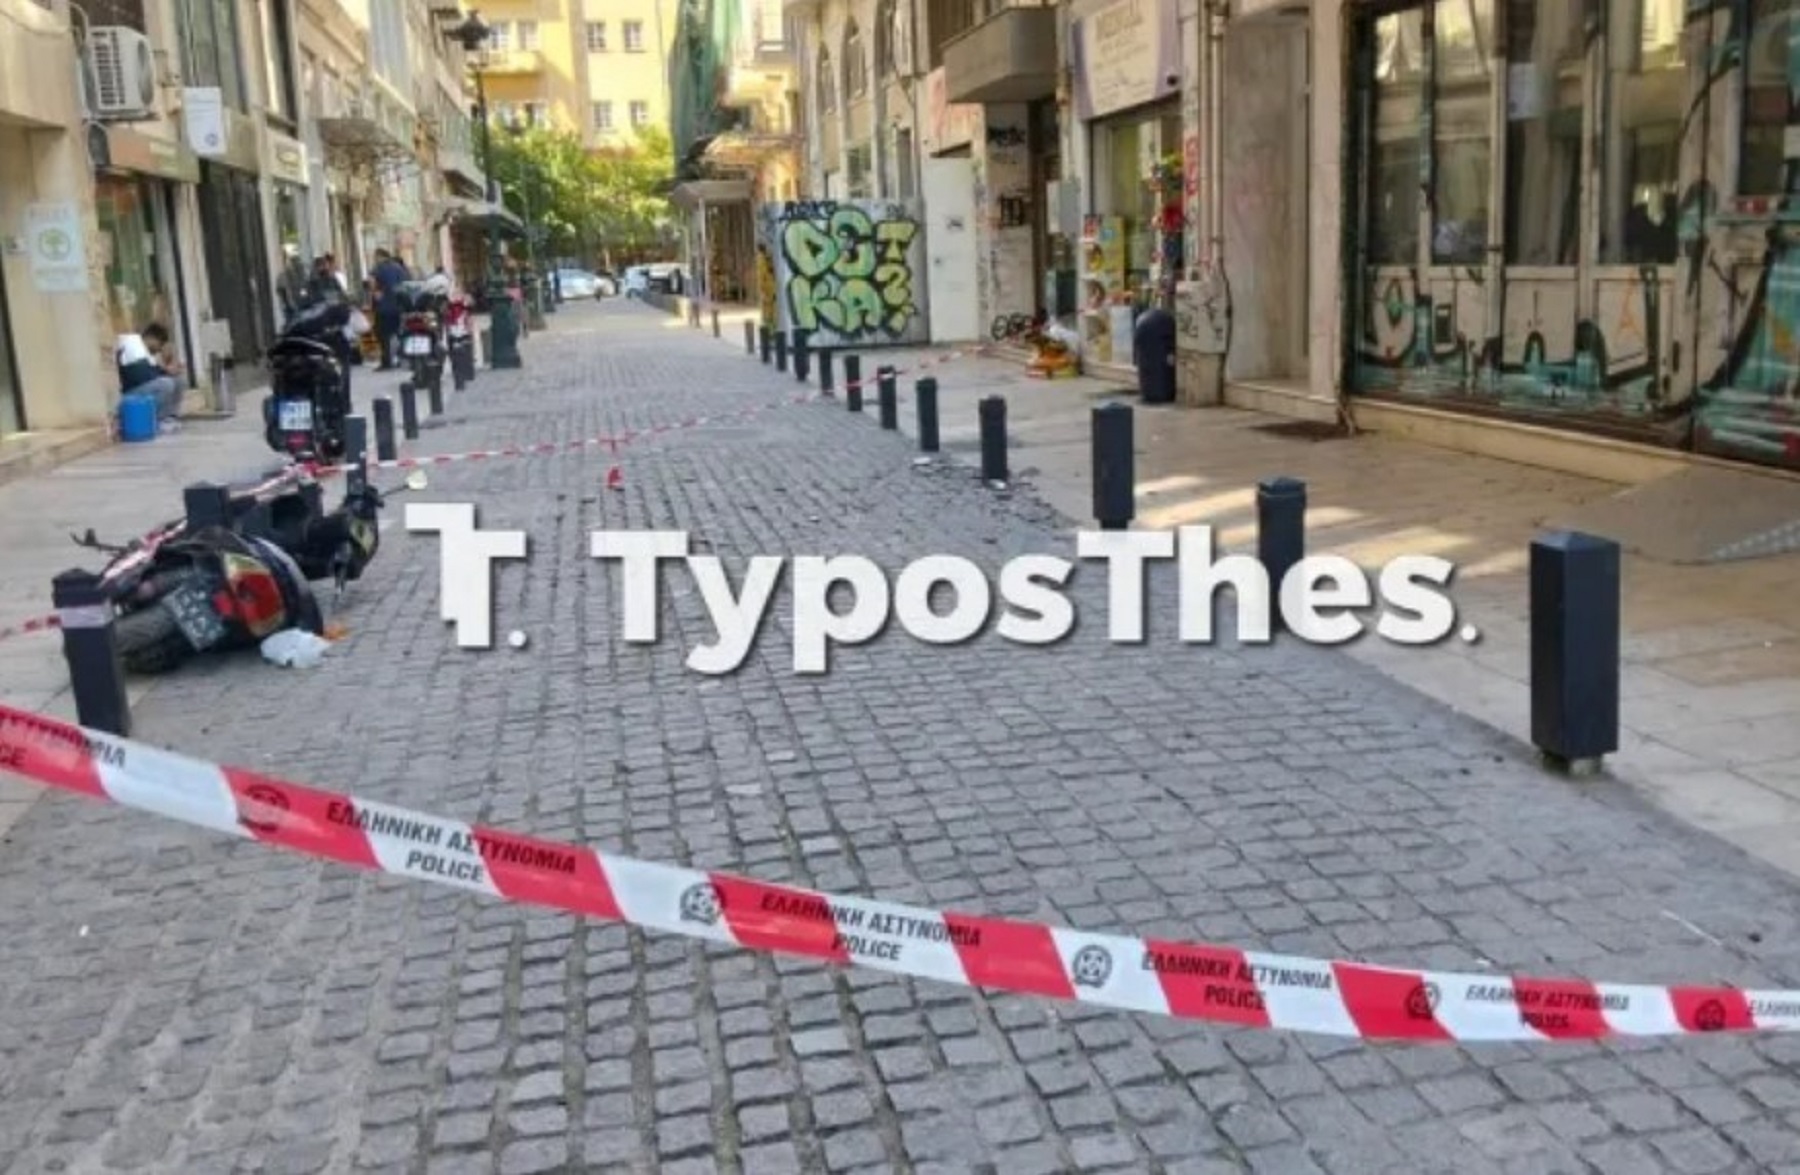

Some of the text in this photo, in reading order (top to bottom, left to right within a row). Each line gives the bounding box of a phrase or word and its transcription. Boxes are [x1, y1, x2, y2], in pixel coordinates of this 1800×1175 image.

[325, 801, 577, 875] ΕΛΛΗΝΙΚΗ ΑΣΤΥΝΟΜΙΑ
[405, 851, 485, 884] POLICE
[761, 892, 982, 947] ΕΛΛΗΝΙΚΗ ΑΣΤΥΝΟΜΙΑ
[831, 931, 903, 962] POLICE
[1203, 985, 1267, 1011] POLICE
